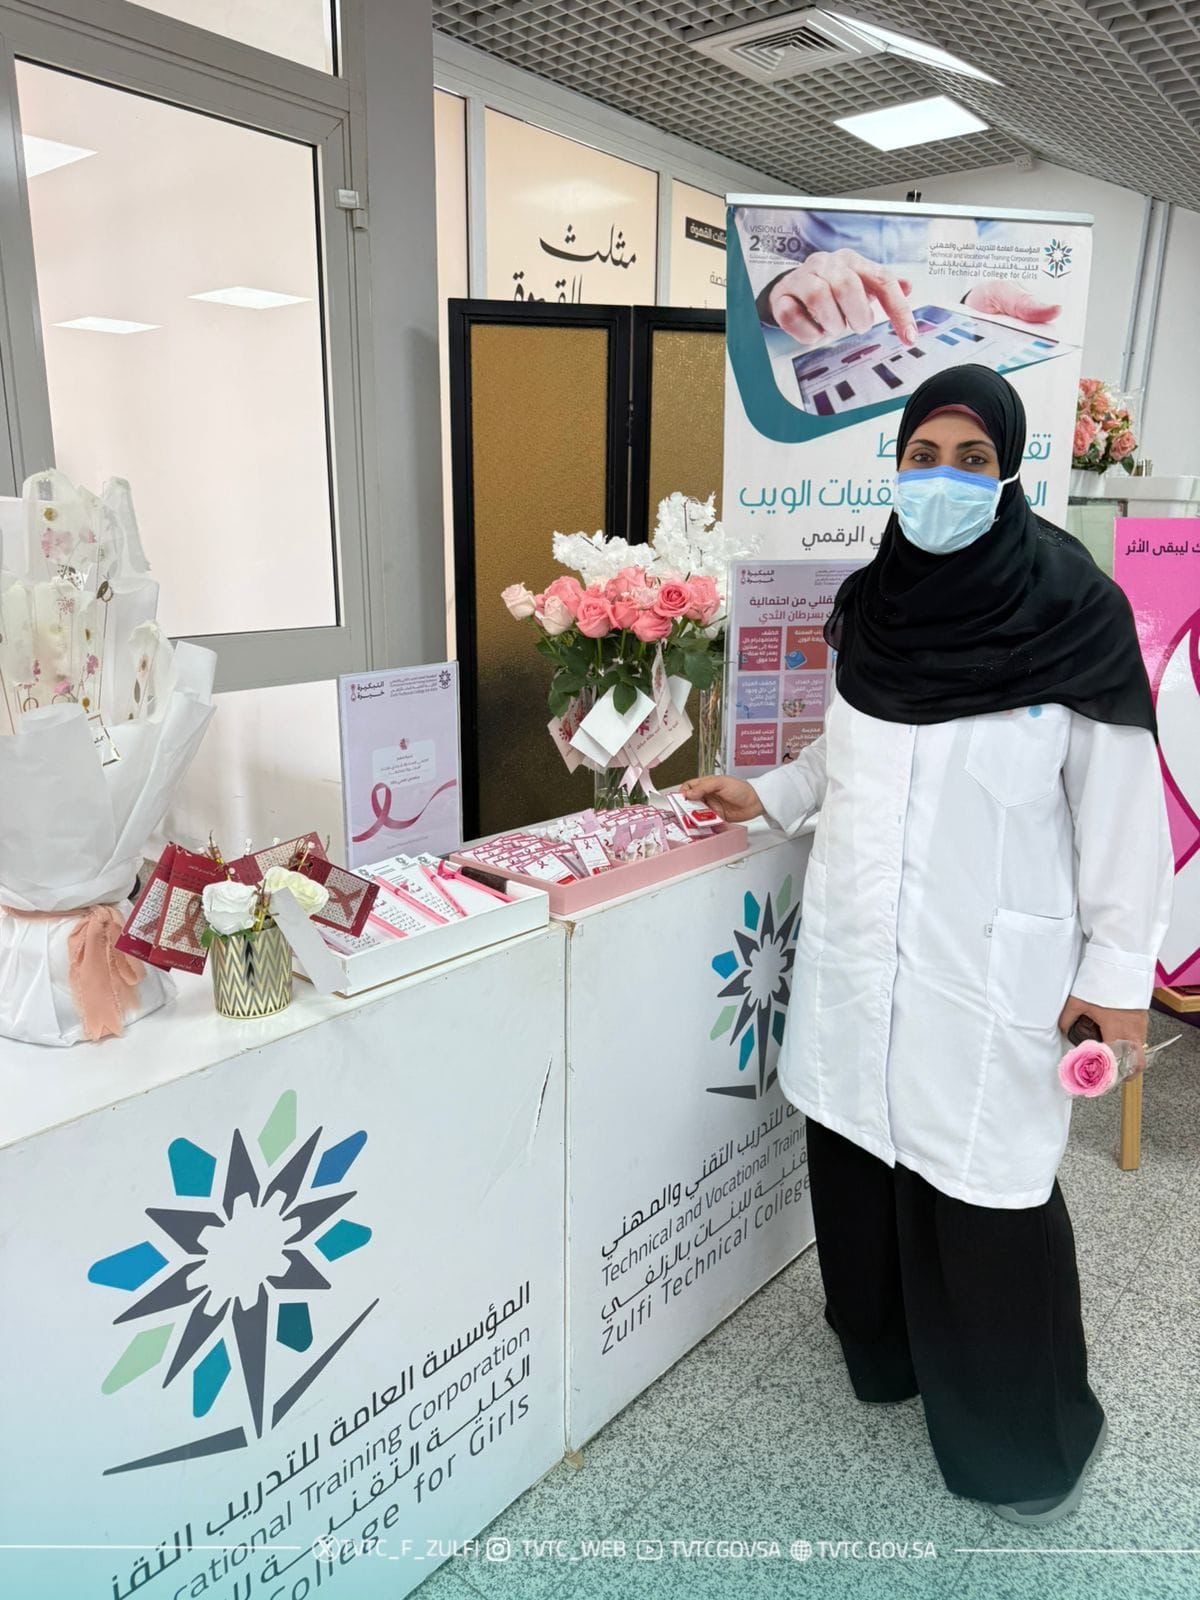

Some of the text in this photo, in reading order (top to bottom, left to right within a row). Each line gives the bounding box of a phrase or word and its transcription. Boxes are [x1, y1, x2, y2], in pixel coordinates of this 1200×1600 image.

[539, 223, 637, 269] مثلث
[750, 224, 777, 234] VISION
[928, 267, 1038, 280] Zulfi Technical College for Girls
[739, 479, 894, 514] قنيات الويب
[801, 526, 865, 551] الرقمي
[1125, 538, 1149, 556] الأثر
[1152, 540, 1189, 556] ليبقى
[749, 595, 835, 609] قللي من احتمالية
[759, 610, 786, 624] الثدي
[788, 610, 824, 622] بسرطان
[601, 1104, 784, 1260] للتدريب التقني والمهني
[601, 1122, 806, 1287] Technical and Vocational Traini
[601, 1146, 808, 1323] قنية للبنات بالزلفي
[601, 1173, 811, 1356] Zulfi Technical College
[300, 1423, 402, 1511] Training
[408, 1327, 530, 1431] Corporation
[112, 1280, 530, 1600] المؤسسة العامة للتدريب التقن
[413, 1453, 456, 1504] for
[469, 1393, 529, 1457] Girls
[260, 1354, 530, 1583] الكلية التقنية
